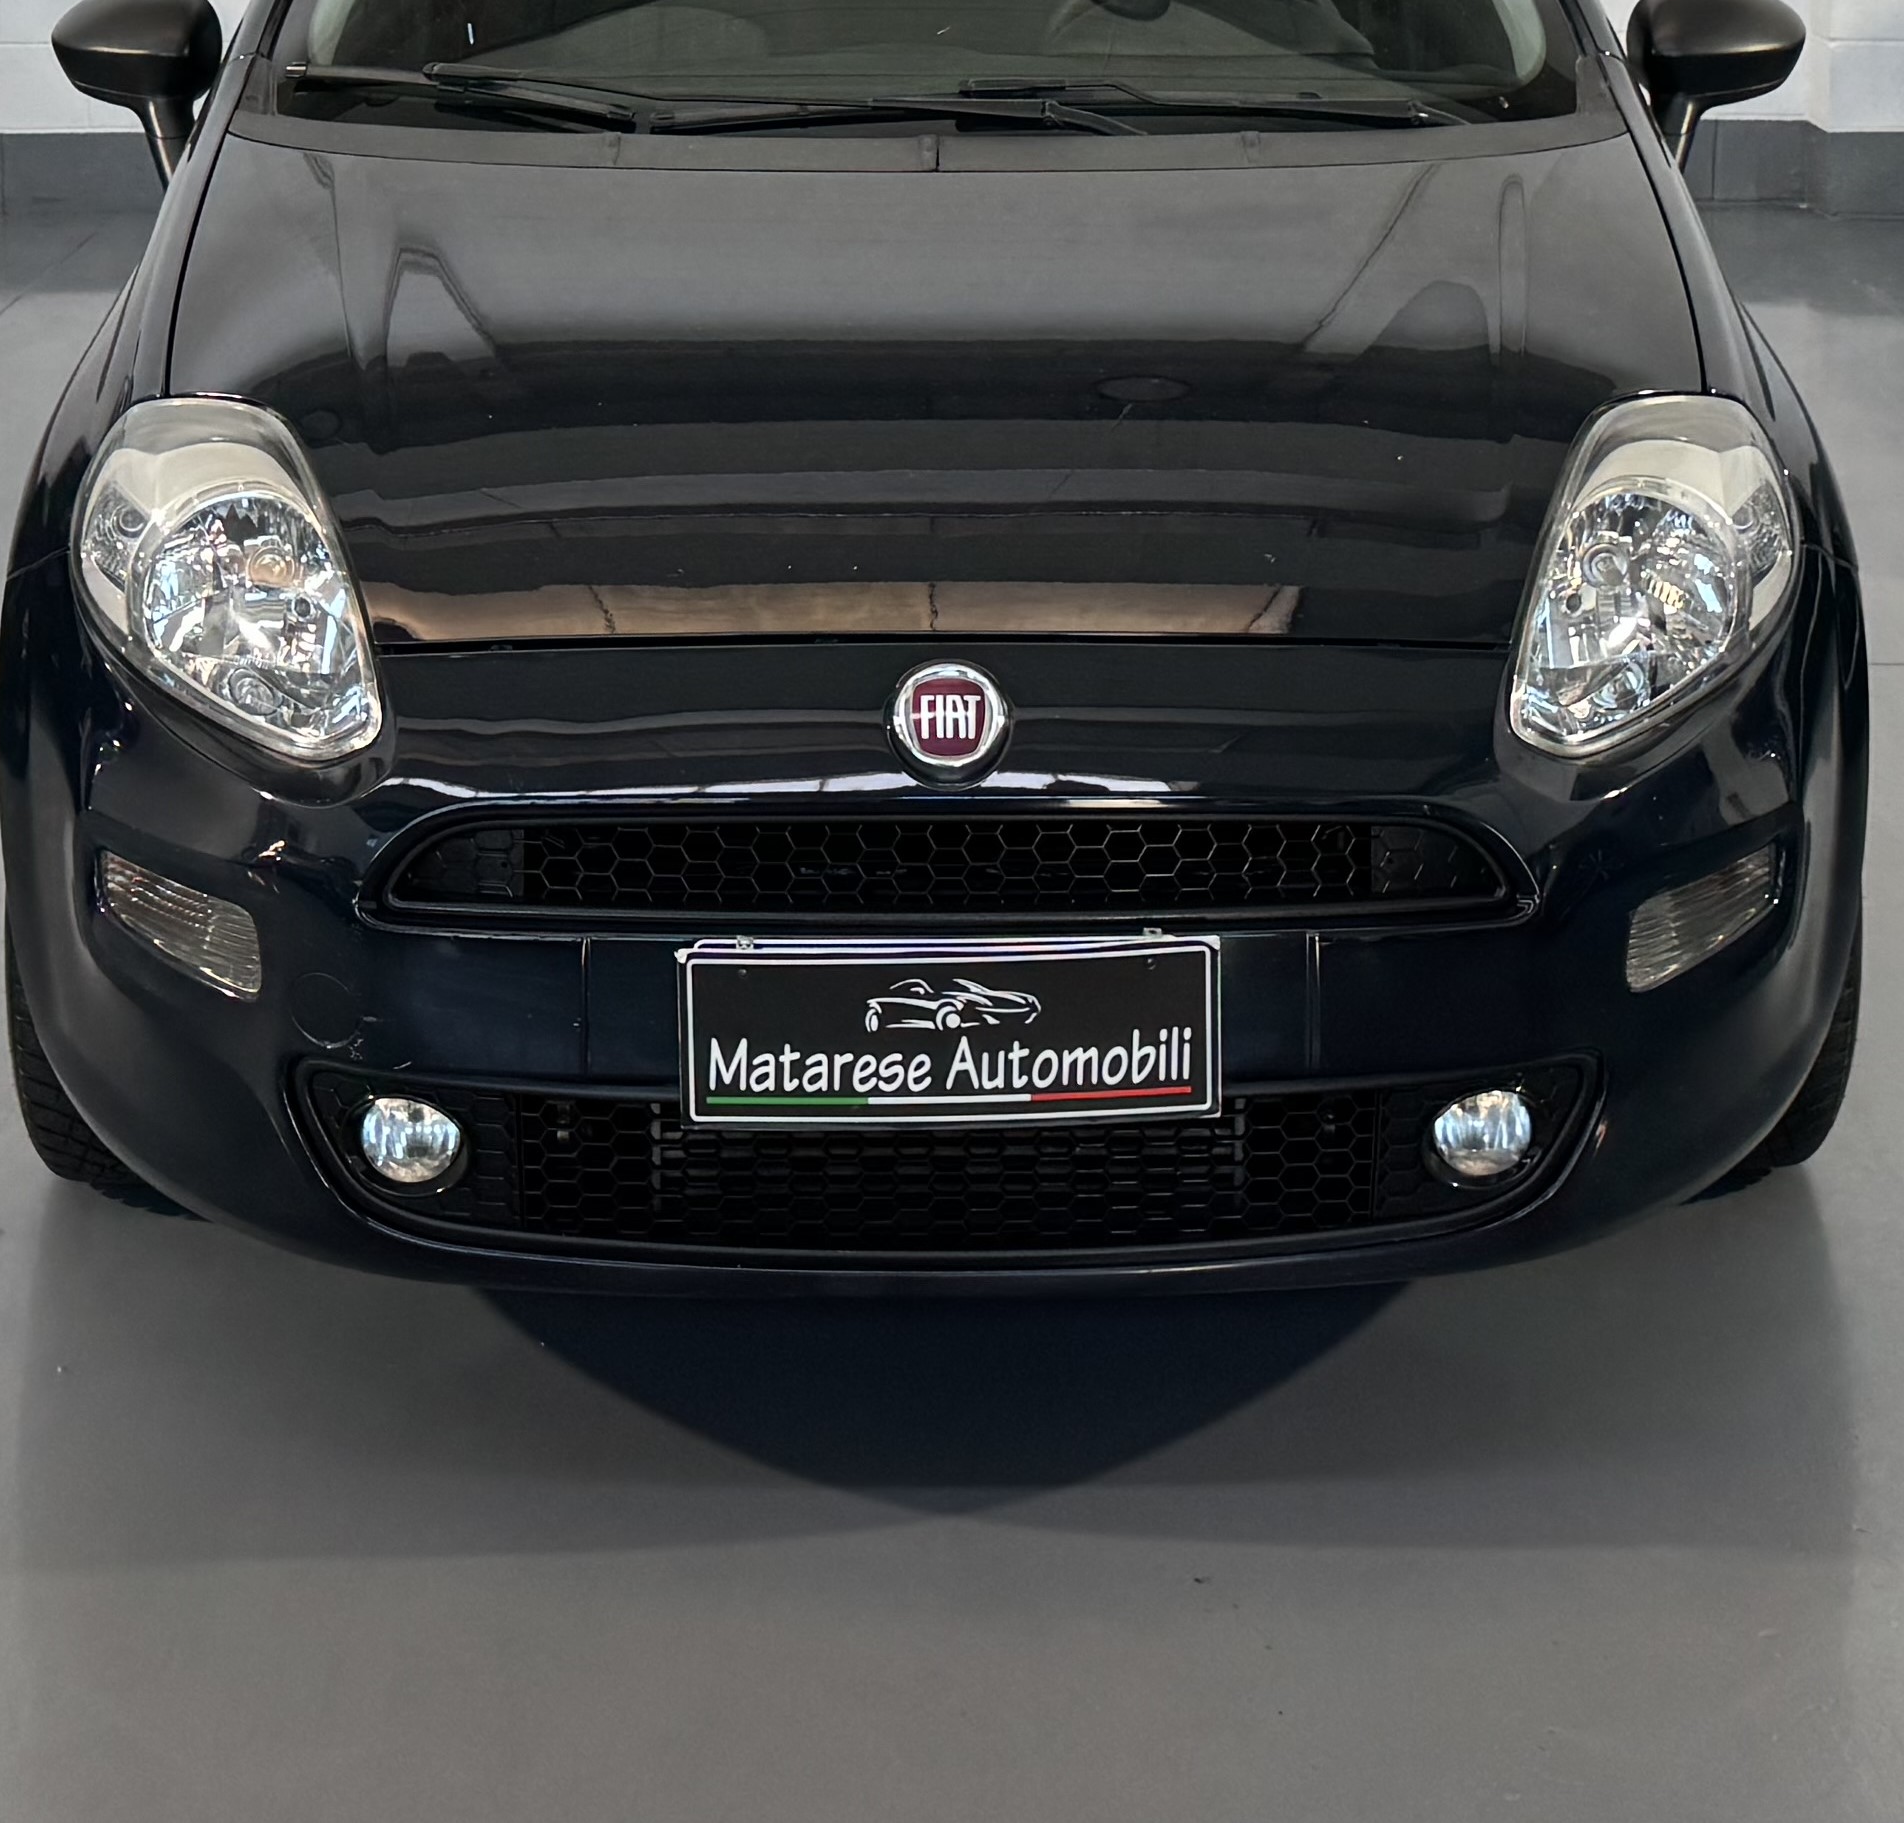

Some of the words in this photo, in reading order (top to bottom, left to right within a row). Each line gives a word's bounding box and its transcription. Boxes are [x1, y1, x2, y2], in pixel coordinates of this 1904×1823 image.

[920, 694, 982, 740] FIAT
[708, 1036, 932, 1093] Matarese
[945, 1026, 1192, 1090] Automobili
